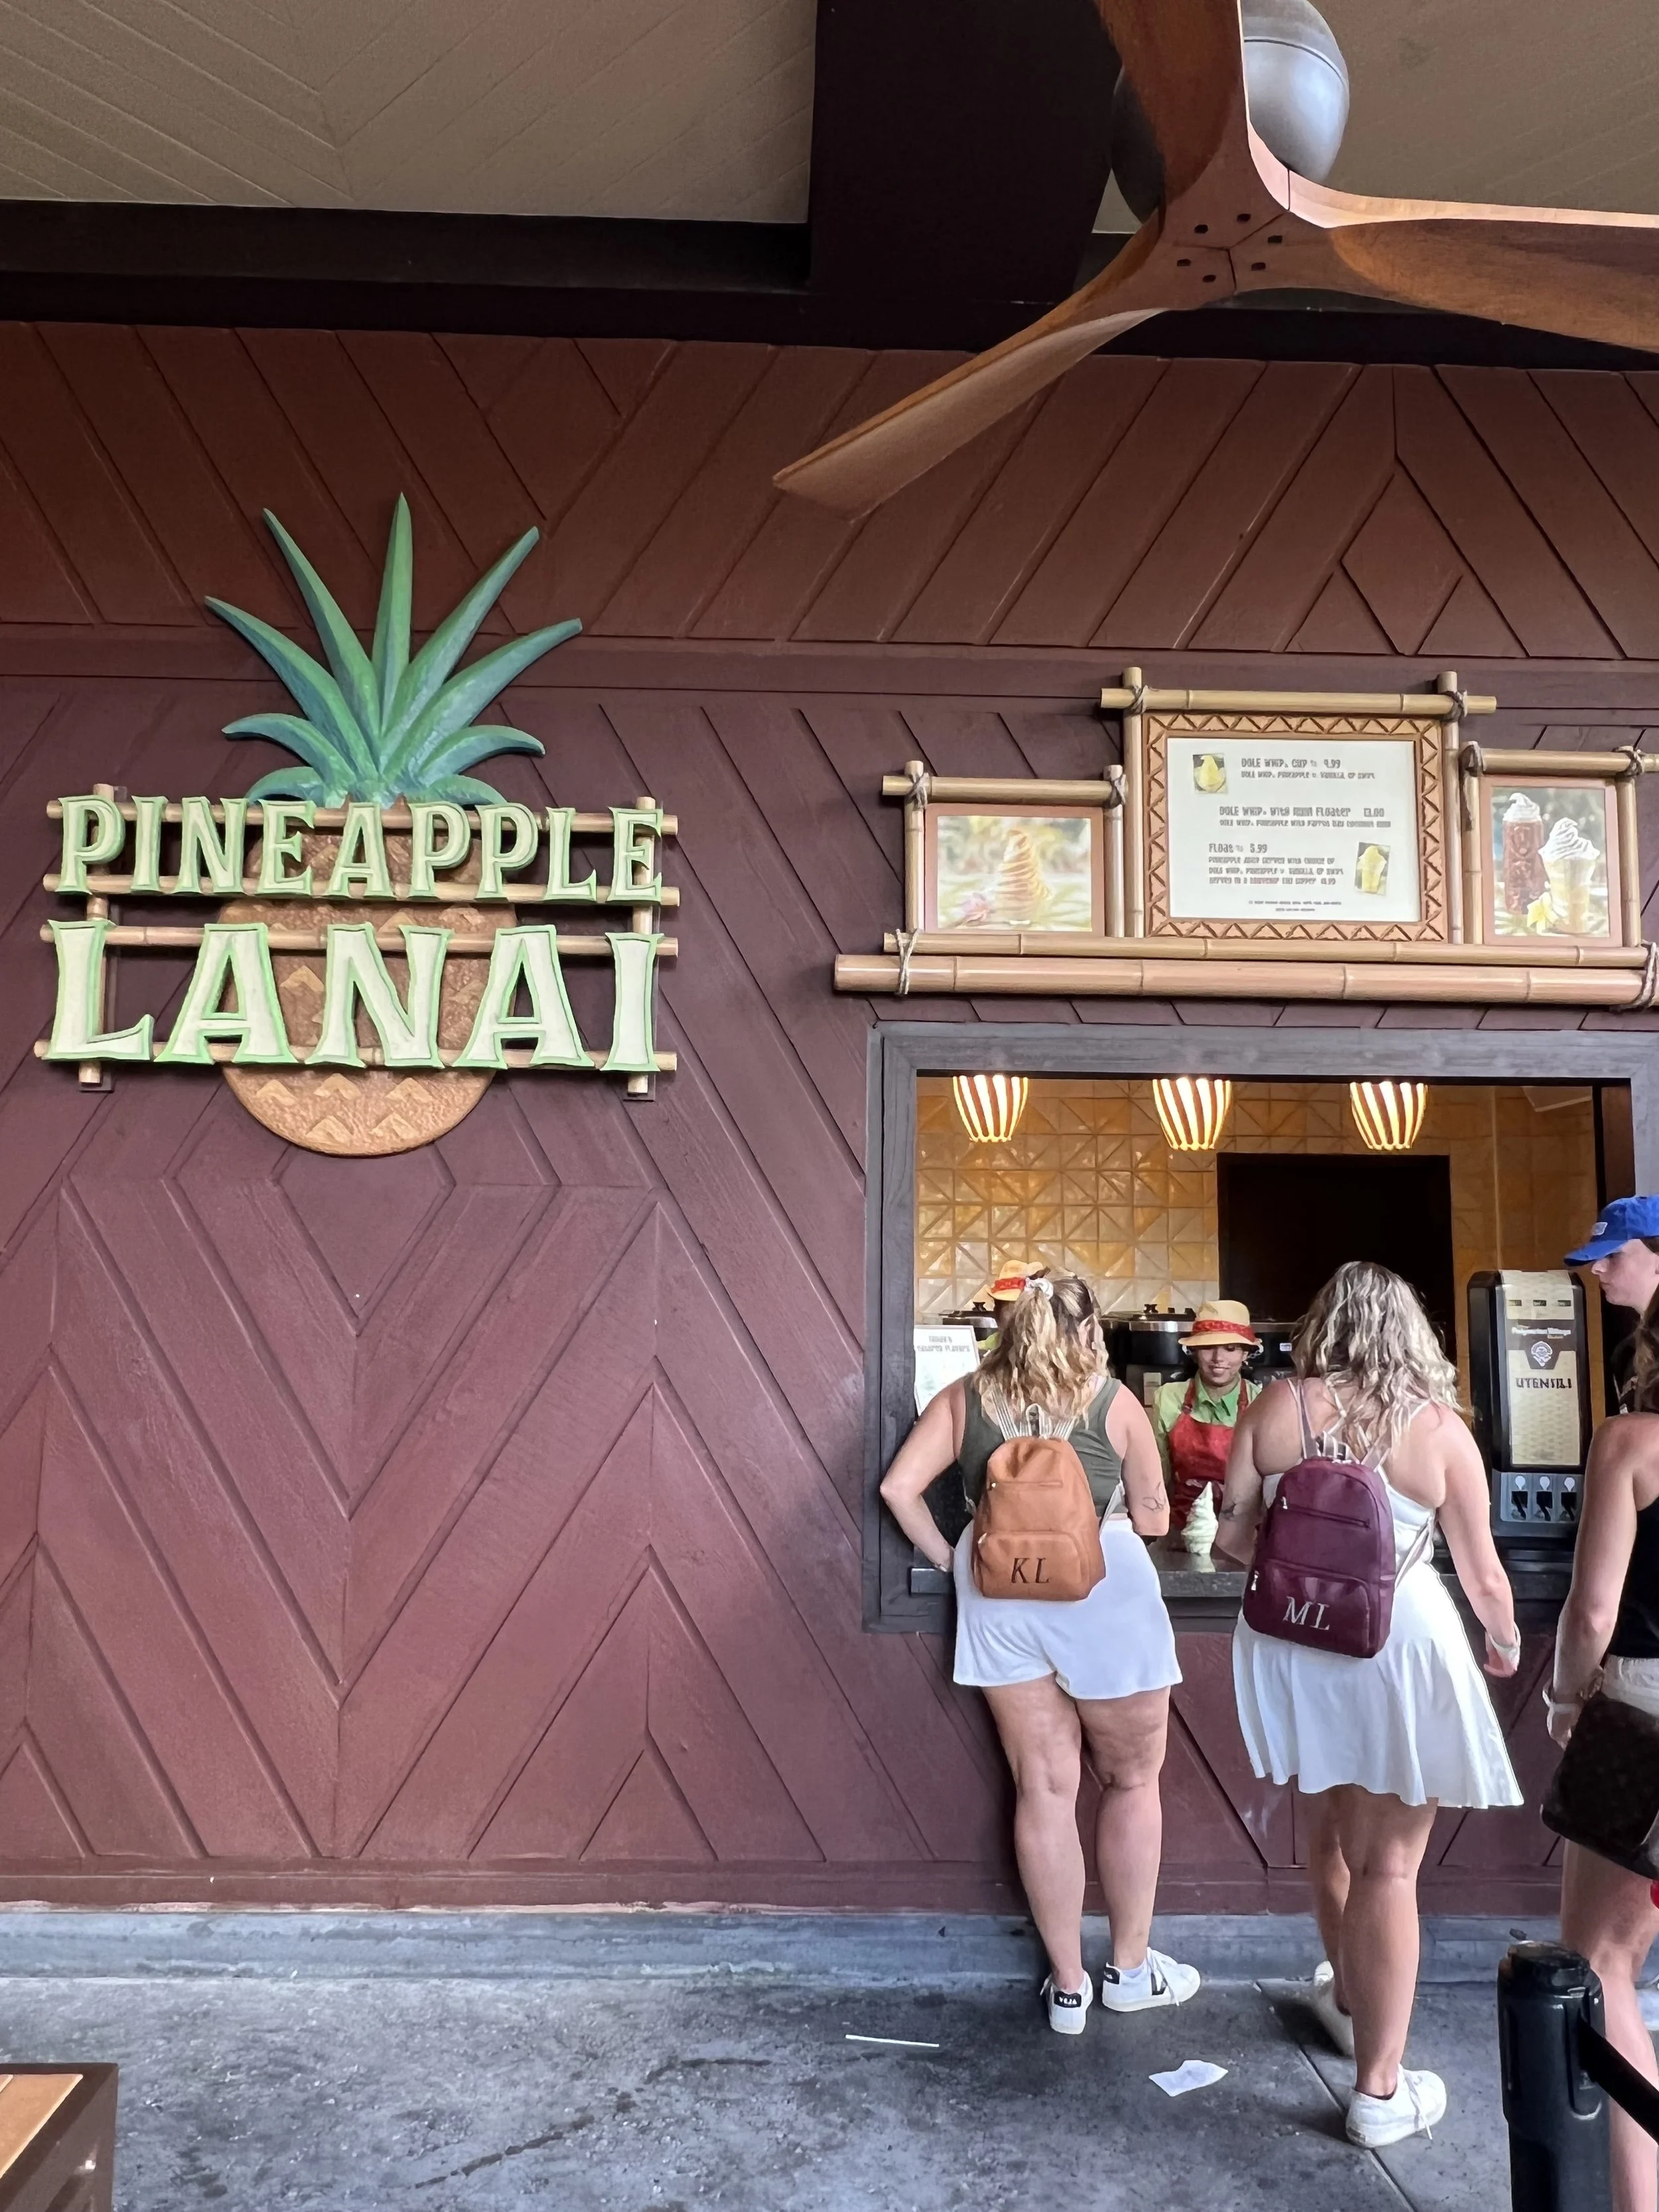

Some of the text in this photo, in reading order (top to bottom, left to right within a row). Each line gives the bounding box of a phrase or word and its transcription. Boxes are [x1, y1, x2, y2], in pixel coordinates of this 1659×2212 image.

[1241, 758, 1261, 768] DOLE
[1219, 806, 1239, 816] DOLE
[56, 796, 663, 903] PINEAPPLE
[42, 919, 665, 1072] LANAI
